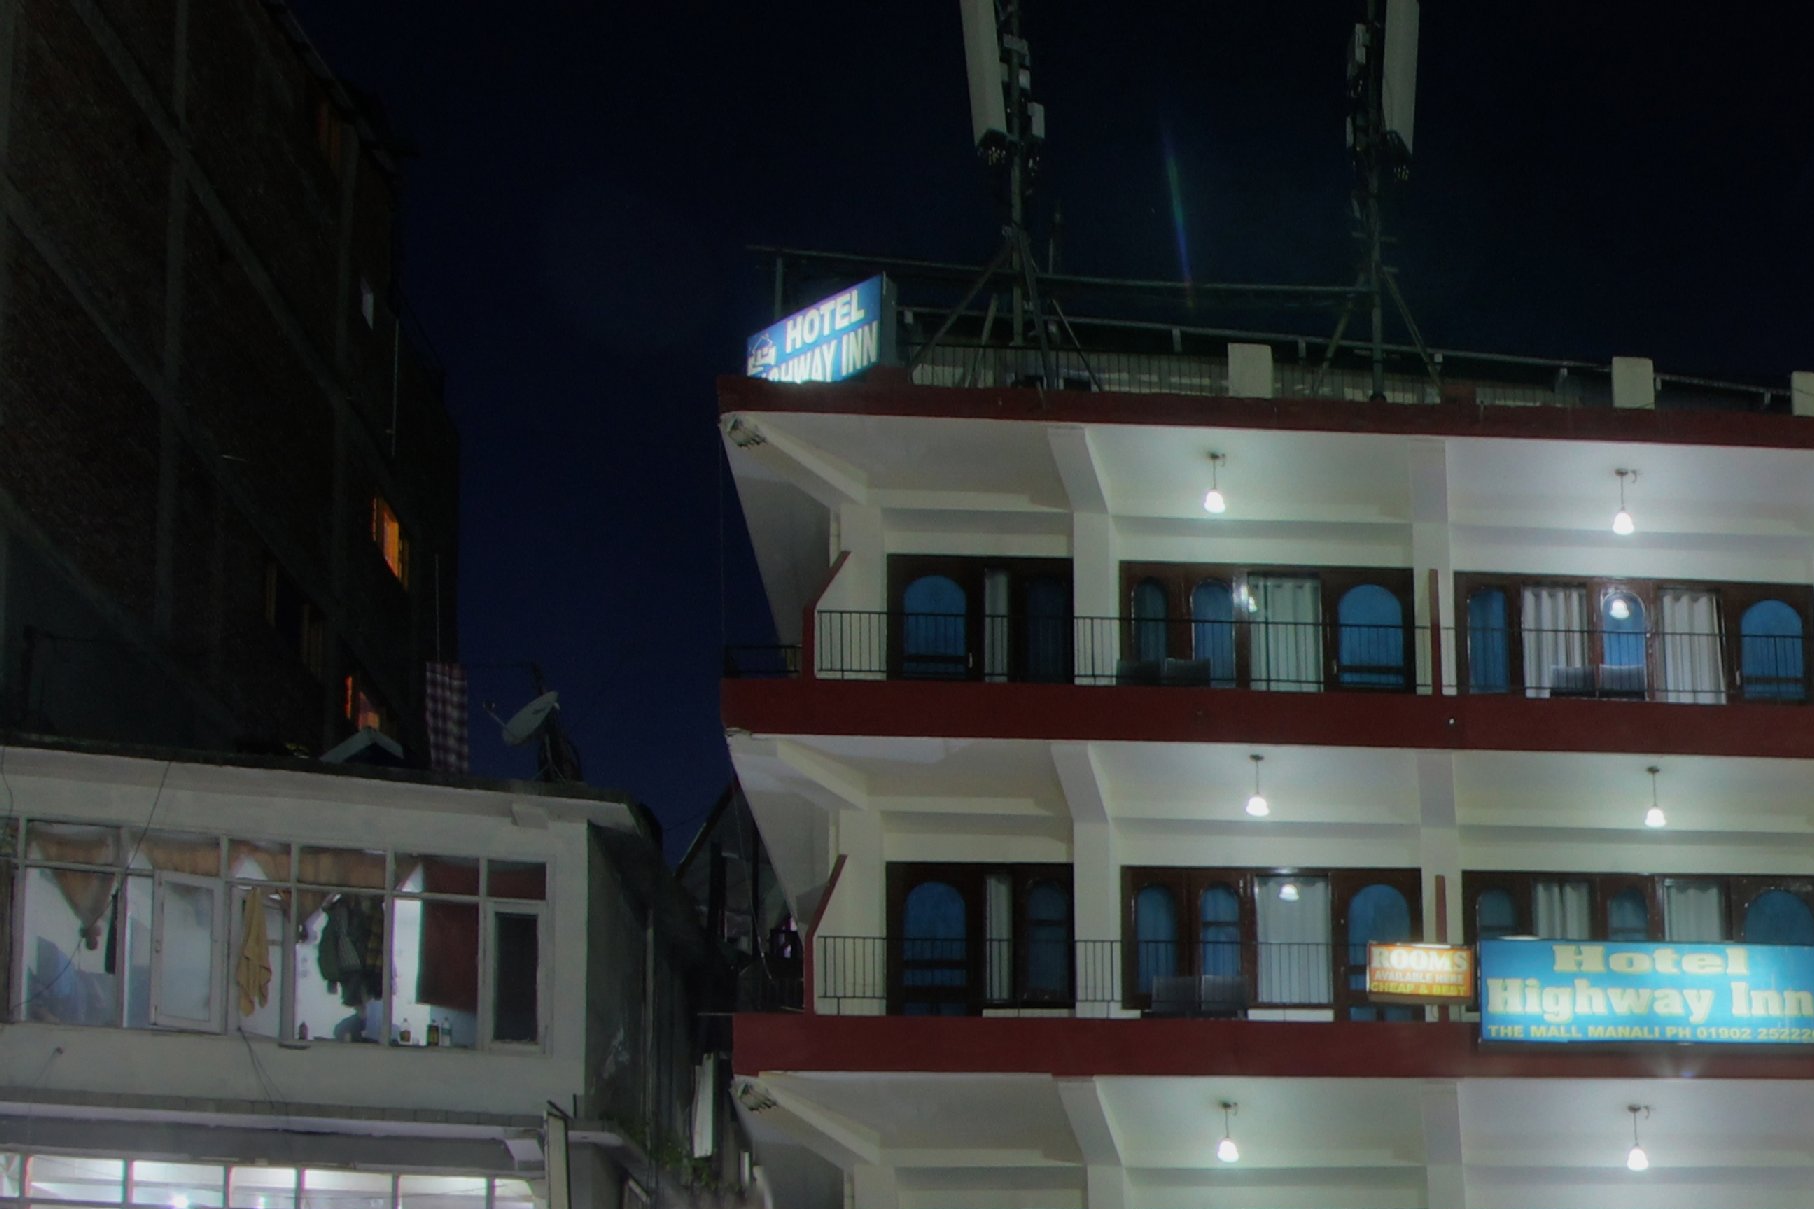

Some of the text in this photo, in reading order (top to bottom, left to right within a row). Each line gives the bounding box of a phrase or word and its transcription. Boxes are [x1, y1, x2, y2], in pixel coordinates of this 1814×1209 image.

[785, 290, 865, 353] HOTEL
[842, 320, 879, 377] INN
[1371, 949, 1467, 971] ROOMS
[1553, 944, 1747, 974] Hotel
[1487, 978, 1814, 1024] Highway Inn
[1488, 1025, 1523, 1037] THE
[1531, 1026, 1581, 1038] MALL
[1588, 1026, 1660, 1038] MANALI
[1666, 1026, 1691, 1038] PH
[1697, 1027, 1750, 1039] 01902
